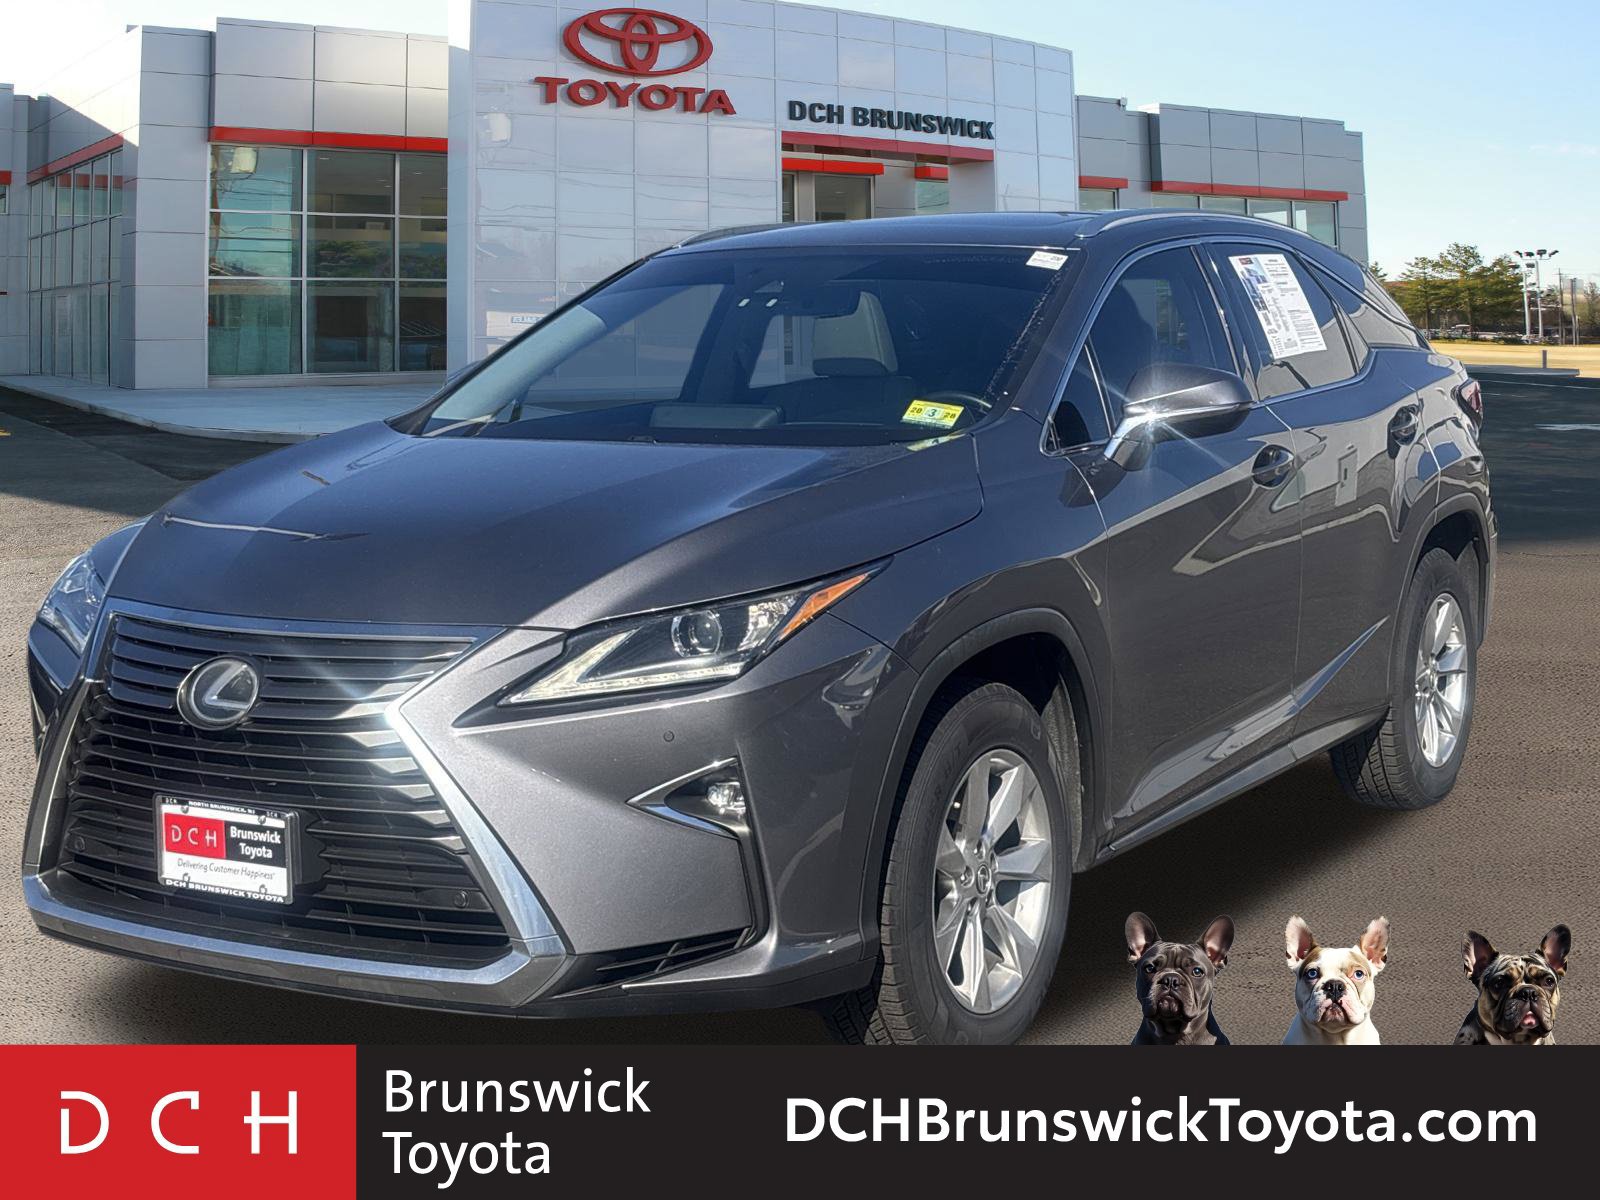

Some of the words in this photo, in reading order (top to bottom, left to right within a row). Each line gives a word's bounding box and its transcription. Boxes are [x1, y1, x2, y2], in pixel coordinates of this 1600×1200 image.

[534, 76, 737, 115] TOYOTA
[788, 100, 845, 125] DCH
[851, 106, 995, 140] BRUNSWICK
[928, 408, 938, 417] 3
[188, 800, 209, 808] NORTH
[171, 824, 217, 848] DCH
[230, 826, 281, 844] Brunswick
[239, 843, 273, 860] Toyota
[177, 857, 208, 873] Delivering
[208, 863, 240, 875] Customer
[241, 866, 274, 880] Happiness
[165, 879, 187, 888] DCH
[188, 883, 246, 898] BRUNSWICK
[246, 891, 284, 904] TOYOTA
